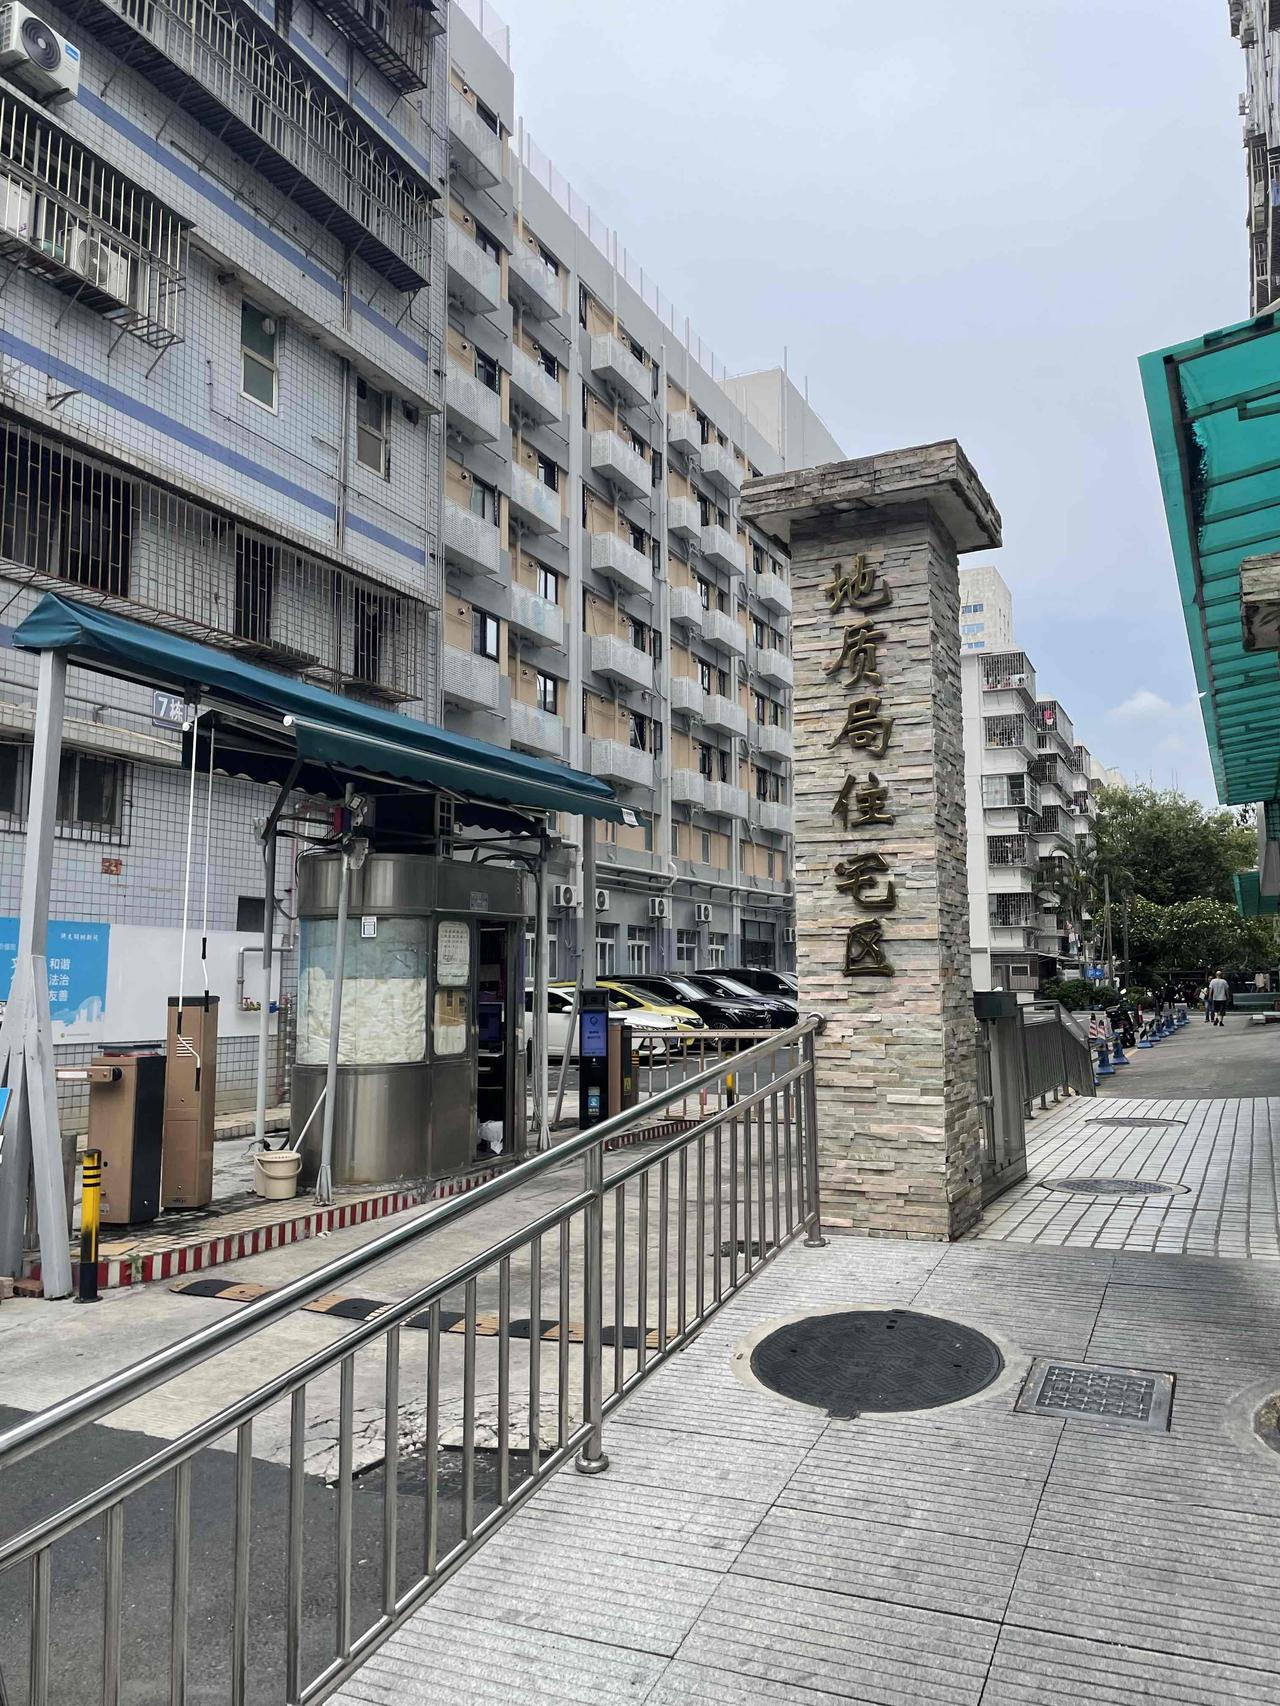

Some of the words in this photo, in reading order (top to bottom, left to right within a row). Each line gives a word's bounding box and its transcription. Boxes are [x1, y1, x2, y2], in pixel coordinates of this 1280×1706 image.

[825, 554, 896, 977] 地质局住宅区
[49, 958, 71, 970] 和谐
[49, 974, 70, 986] 法治
[48, 990, 69, 1002] 友善
